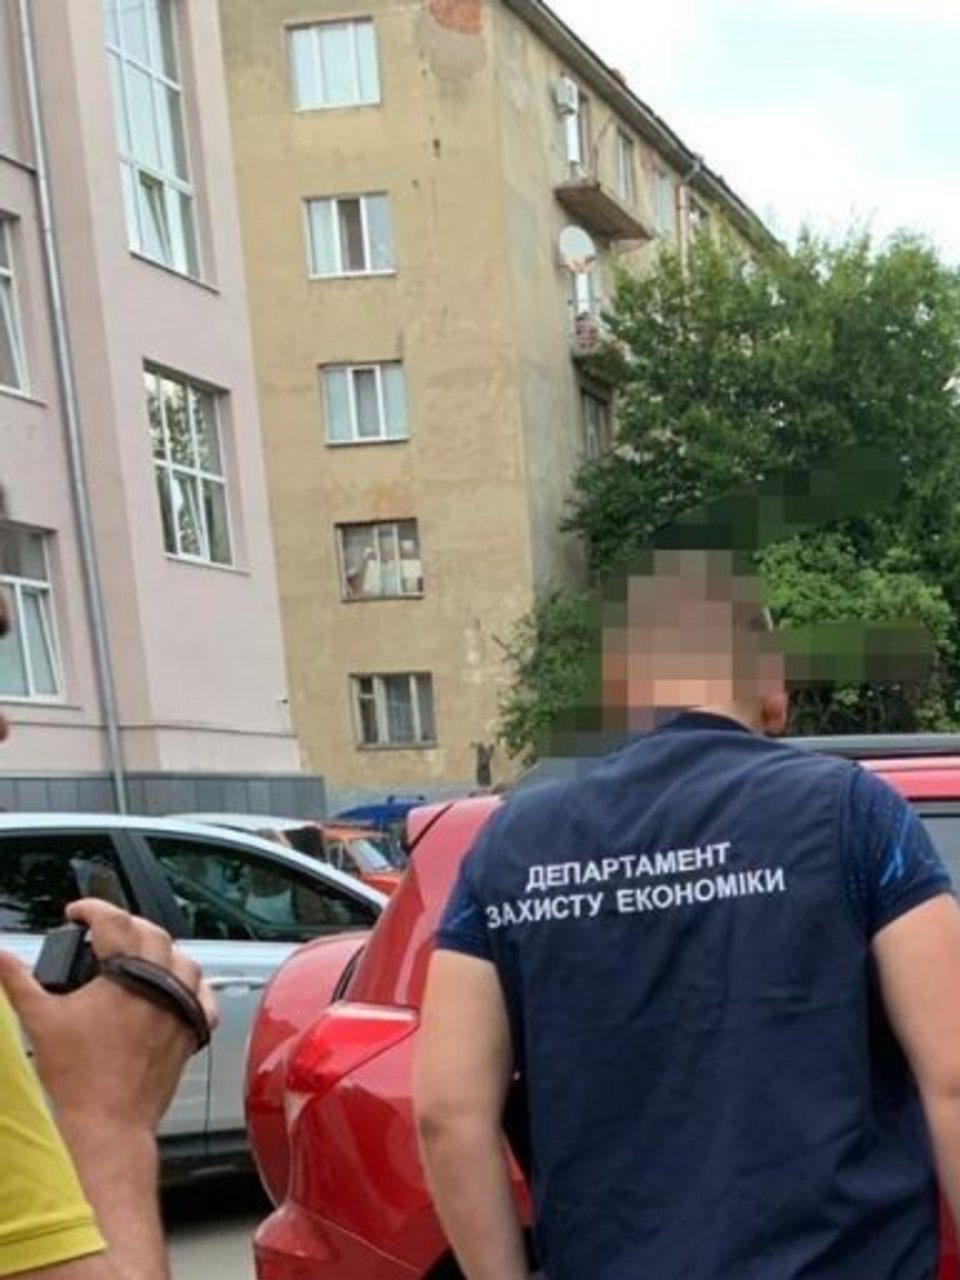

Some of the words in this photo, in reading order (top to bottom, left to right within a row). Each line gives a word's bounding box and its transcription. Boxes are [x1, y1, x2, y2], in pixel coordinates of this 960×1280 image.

[526, 842, 731, 892] ДЕПАРТАМЕНТ
[486, 891, 604, 928] ЗАХИСТУ
[616, 867, 786, 914] ЕКОНОМІКИ
